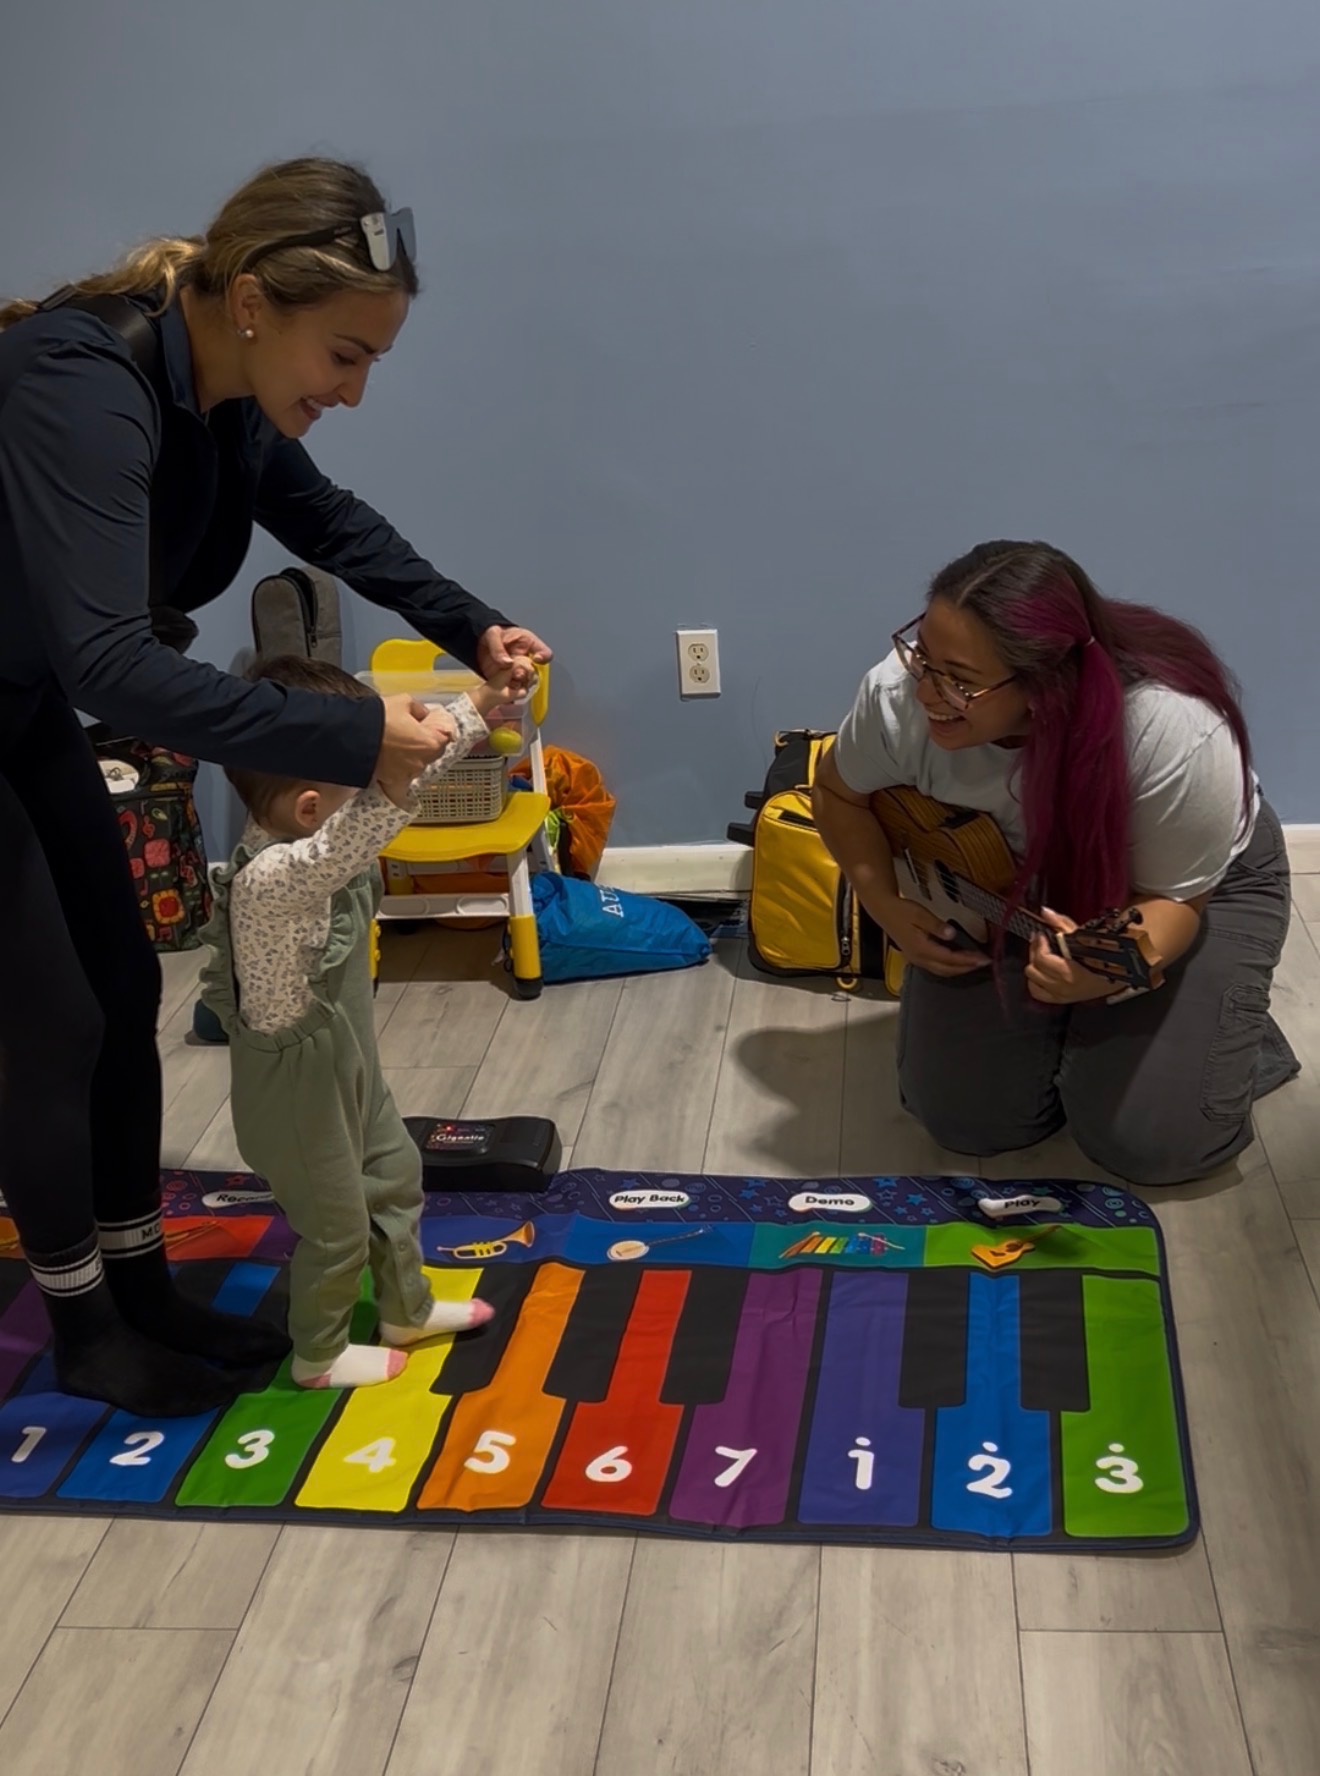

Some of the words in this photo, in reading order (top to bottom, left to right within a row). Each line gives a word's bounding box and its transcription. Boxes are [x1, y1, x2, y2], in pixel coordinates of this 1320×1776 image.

[599, 886, 624, 918] AU
[614, 1194, 646, 1205] Play
[649, 1194, 685, 1203] Back
[804, 1195, 855, 1206] Demo
[1004, 1199, 1041, 1209] Play
[11, 1426, 47, 1463] 1
[109, 1431, 165, 1466] 2
[225, 1429, 275, 1469] 3
[344, 1437, 397, 1473] 4
[464, 1430, 516, 1474] 5
[585, 1445, 632, 1483] 6
[714, 1445, 757, 1488] 7
